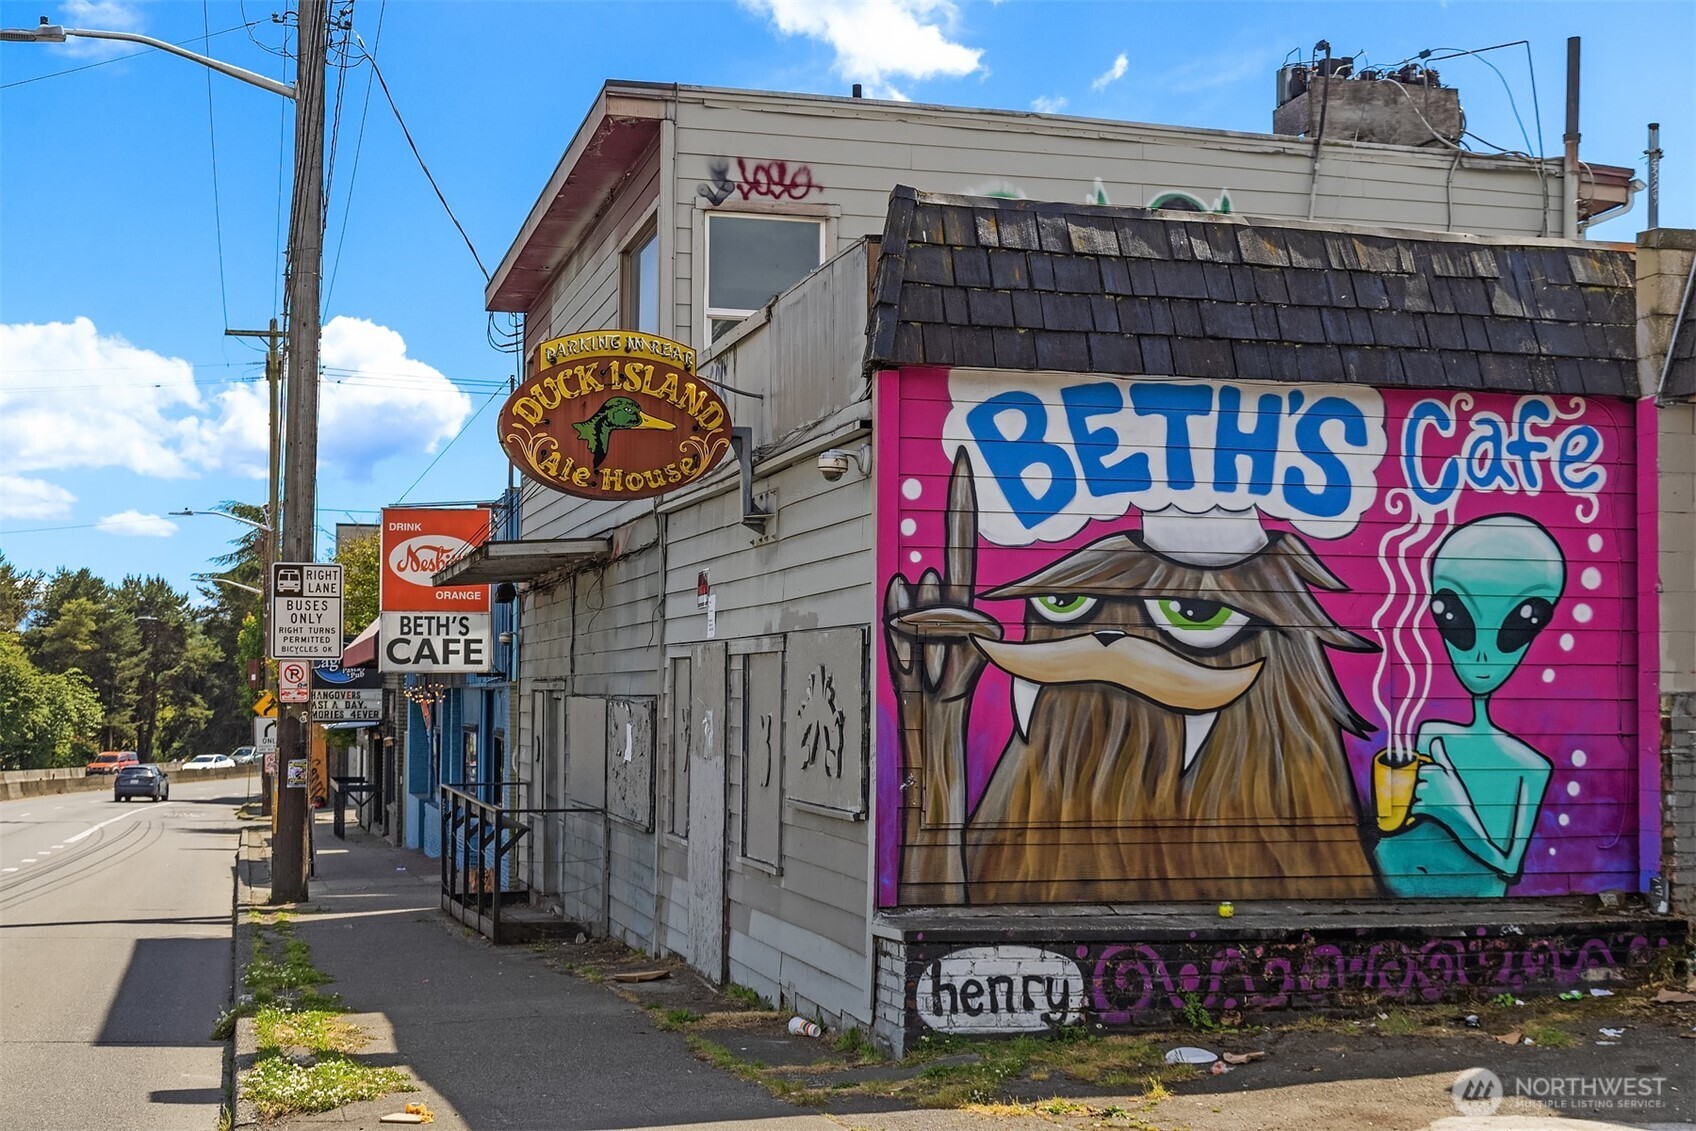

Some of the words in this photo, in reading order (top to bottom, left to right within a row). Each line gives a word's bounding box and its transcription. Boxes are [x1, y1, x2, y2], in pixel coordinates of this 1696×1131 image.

[546, 334, 621, 361] PARKING
[650, 340, 694, 365] REAR
[511, 361, 604, 427] DUCK
[609, 360, 724, 430] ISLAND
[966, 381, 1368, 530] BETH'S
[1403, 397, 1603, 505] Cafe
[538, 451, 591, 487] Ale
[602, 457, 699, 491] House
[389, 523, 422, 531] DRINK
[306, 570, 339, 581] RIGHT
[308, 583, 337, 593] LANE
[435, 591, 482, 600] ORANGE
[287, 600, 328, 611] BUSES
[290, 613, 323, 624] ONLY
[400, 616, 470, 637] BETH'S
[281, 646, 319, 654] BICYCLES
[386, 637, 484, 665] CAFE
[350, 710, 379, 719] 4EVER
[932, 960, 1072, 1025] henry
